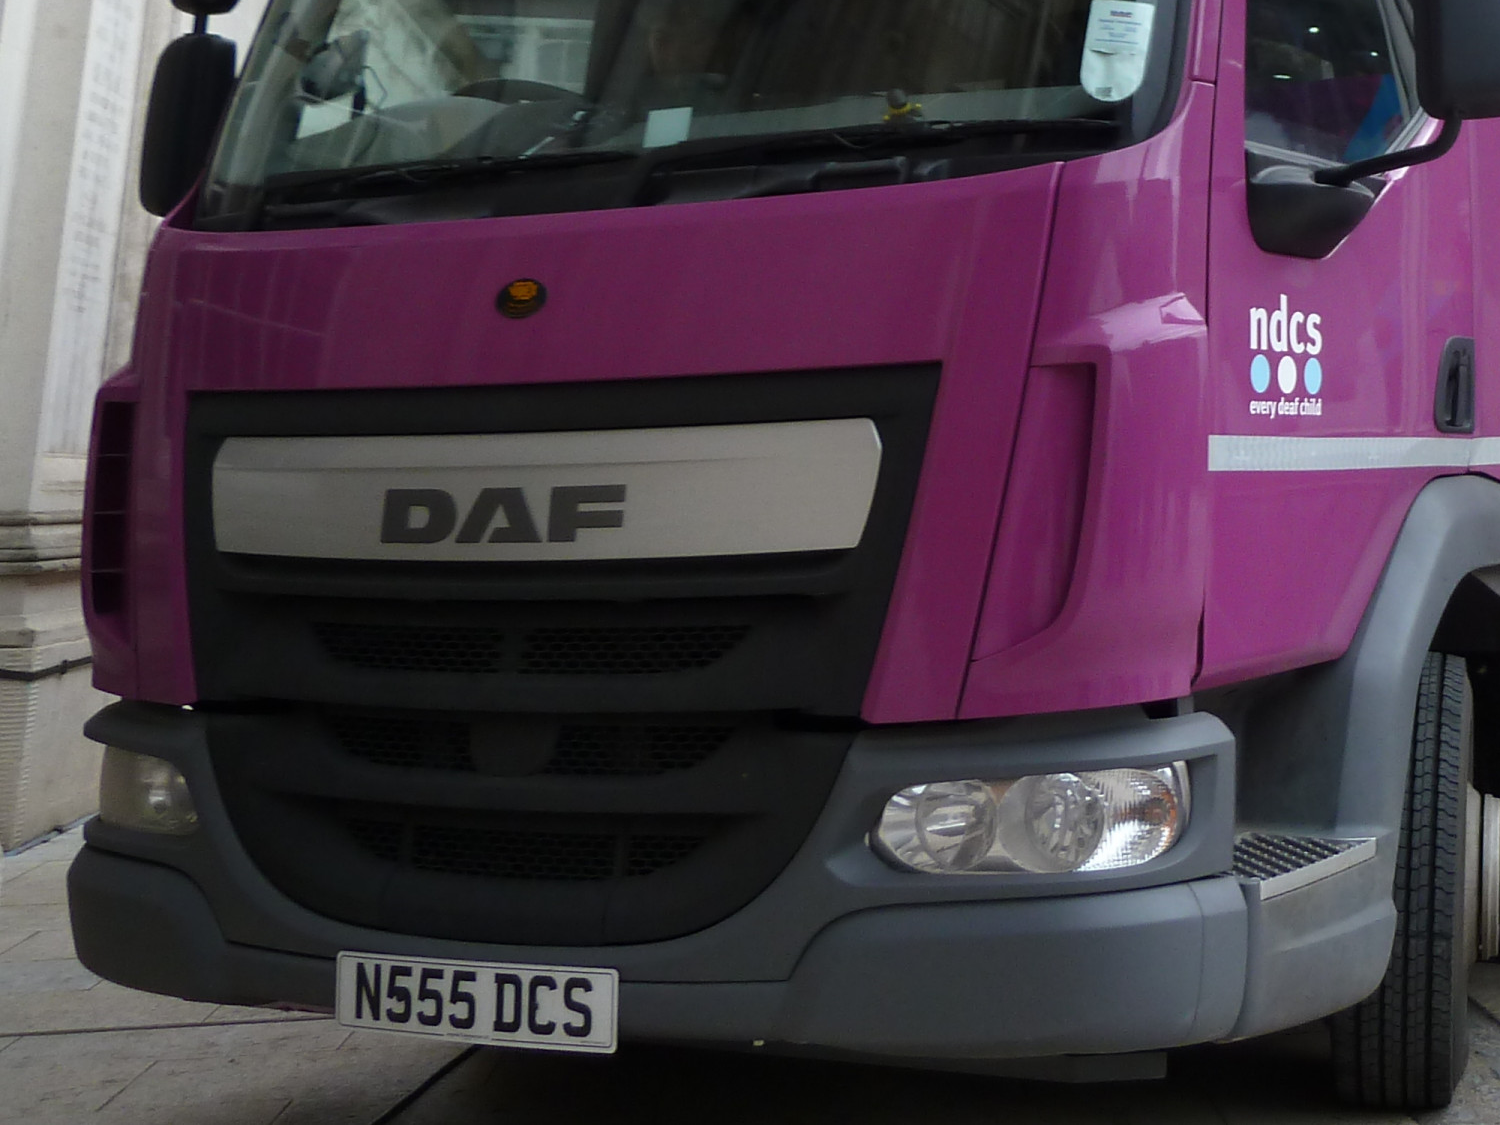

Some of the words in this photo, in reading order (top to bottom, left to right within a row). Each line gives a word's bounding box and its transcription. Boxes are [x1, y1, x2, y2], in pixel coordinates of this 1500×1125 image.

[1249, 293, 1322, 355] ndcs
[1249, 399, 1277, 420] every
[1277, 396, 1300, 415] deaf
[1300, 397, 1322, 416] child
[380, 484, 627, 544] DAF
[355, 961, 478, 1030] N555
[493, 972, 593, 1038] DCS
